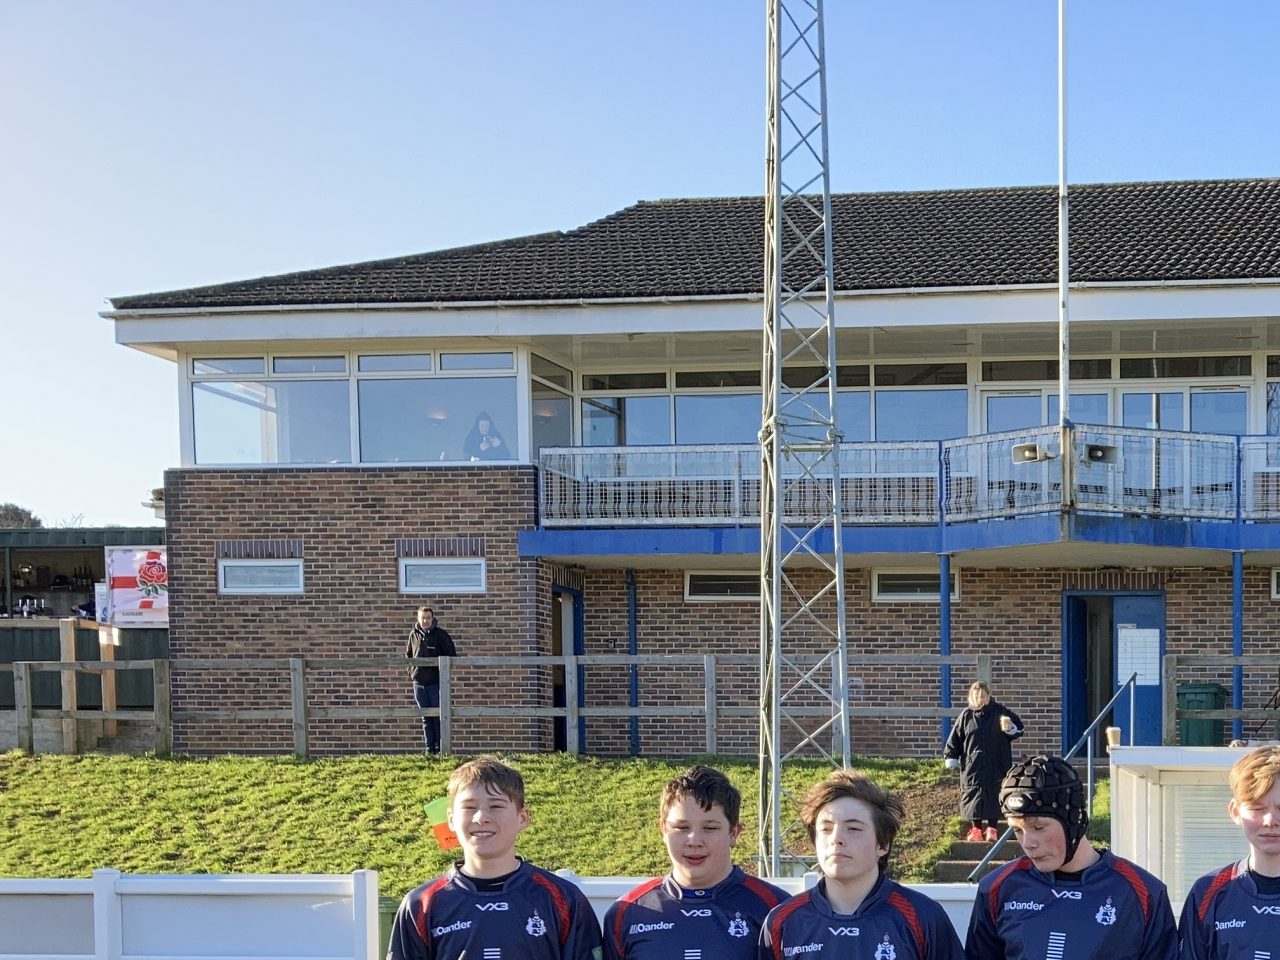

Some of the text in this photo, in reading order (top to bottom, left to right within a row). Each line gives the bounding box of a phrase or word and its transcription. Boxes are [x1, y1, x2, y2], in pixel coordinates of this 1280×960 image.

[1051, 889, 1083, 900] VX3
[475, 902, 509, 912] VX3
[1009, 900, 1045, 911] Oander
[680, 909, 712, 917] VX3
[436, 919, 473, 936] Oander
[636, 921, 675, 933] Oander
[828, 926, 860, 937] VX3
